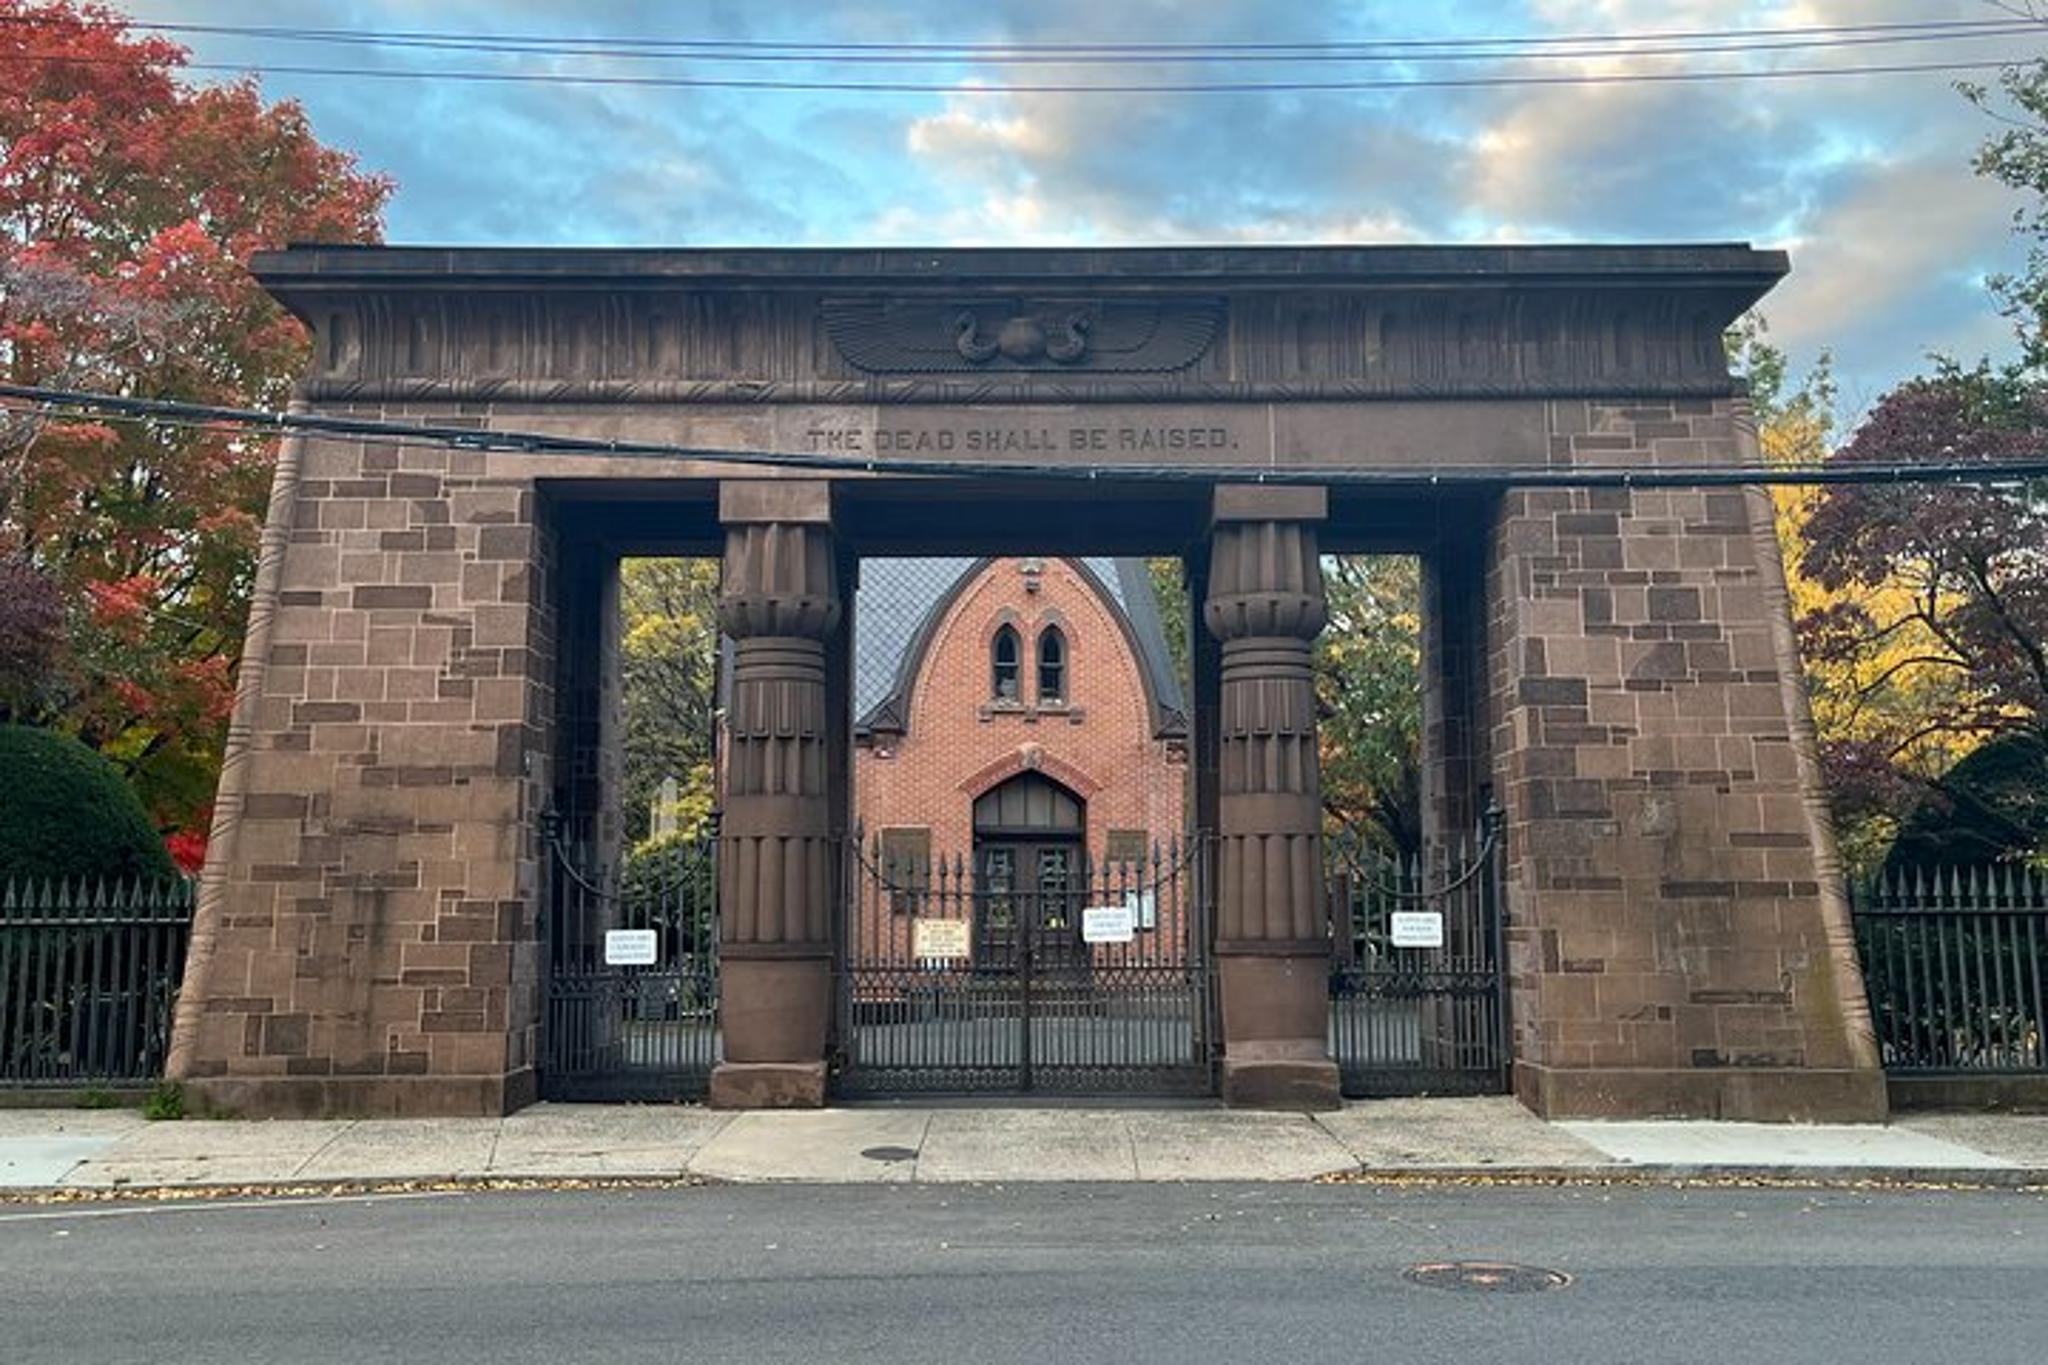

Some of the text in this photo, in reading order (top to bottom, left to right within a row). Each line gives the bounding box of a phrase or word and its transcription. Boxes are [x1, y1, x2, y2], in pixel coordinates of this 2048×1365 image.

[807, 428, 1240, 451] THE DEAD SHALL BE RAISED.
